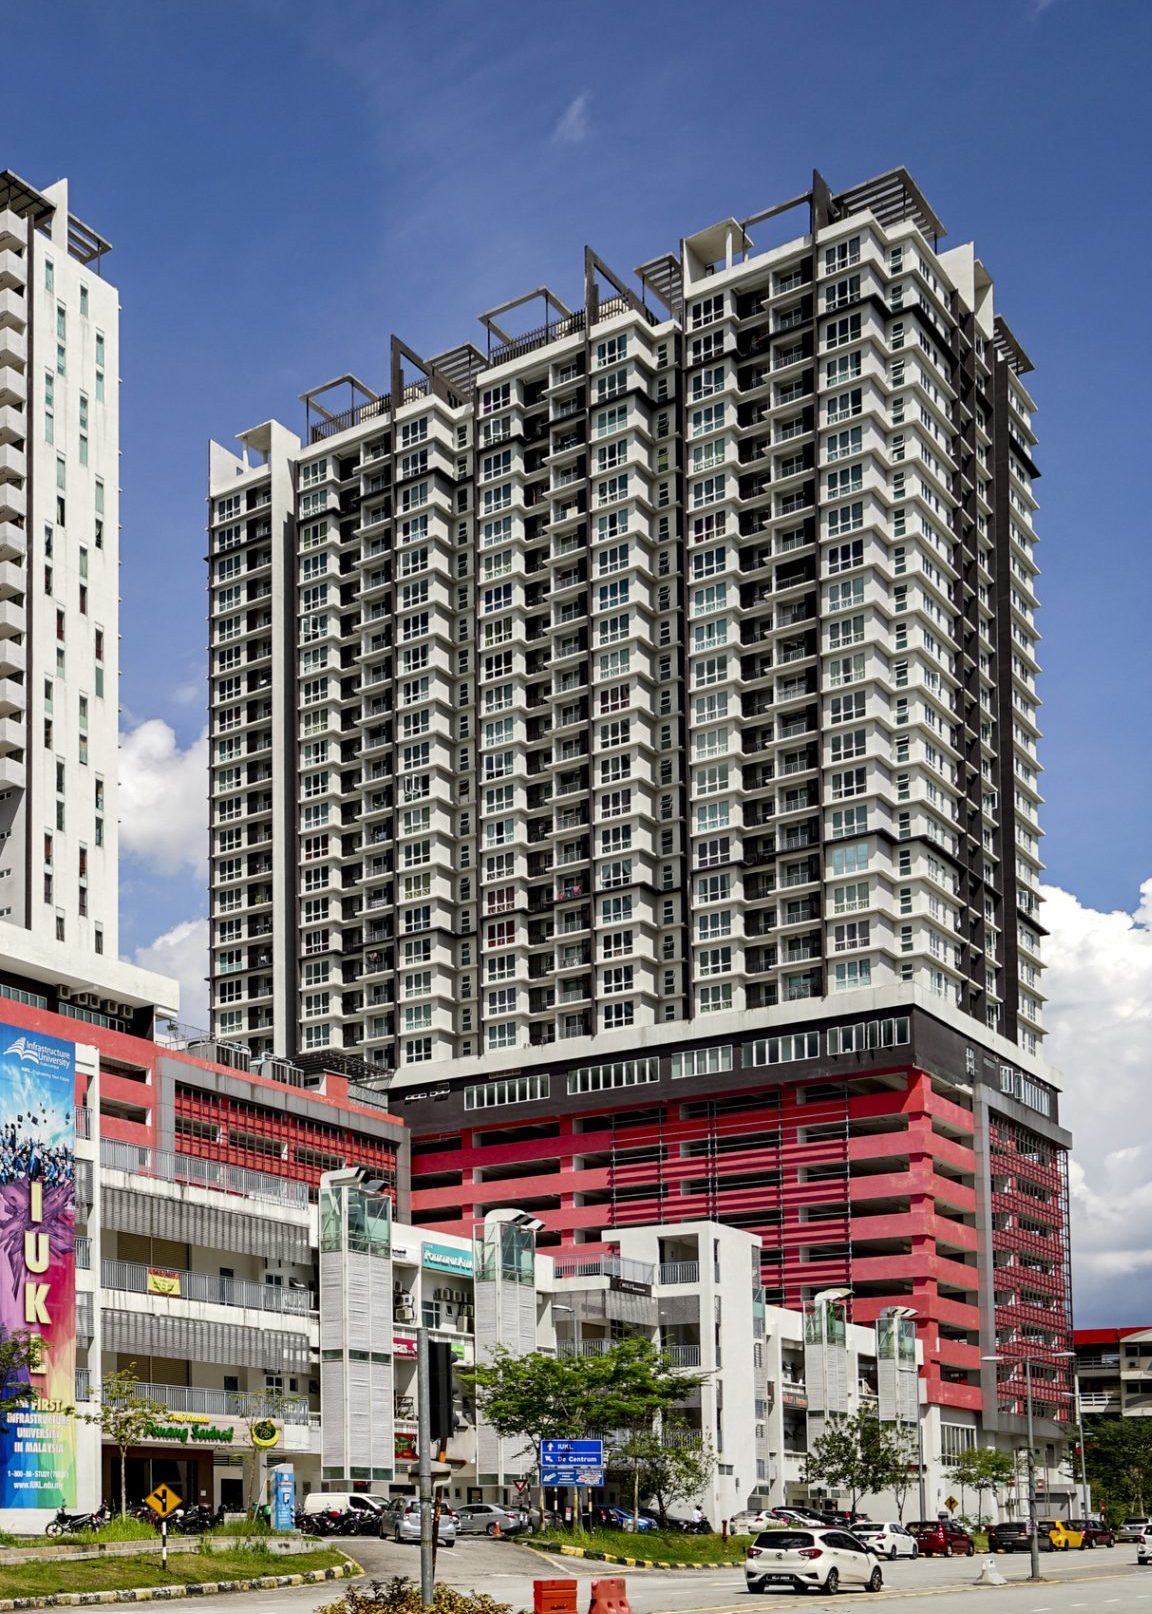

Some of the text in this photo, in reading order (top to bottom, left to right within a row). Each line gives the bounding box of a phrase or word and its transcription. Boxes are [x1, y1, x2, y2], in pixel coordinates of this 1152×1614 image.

[26, 1040, 70, 1059] Infrastructure
[38, 1052, 70, 1069] University
[31, 1398, 62, 1412] FIRST
[7, 1413, 71, 1425] INFRASTRUCTURE
[17, 1427, 62, 1438] UNIVERSITY
[14, 1441, 65, 1453] IN MALAYSIA
[284, 1493, 291, 1503] P
